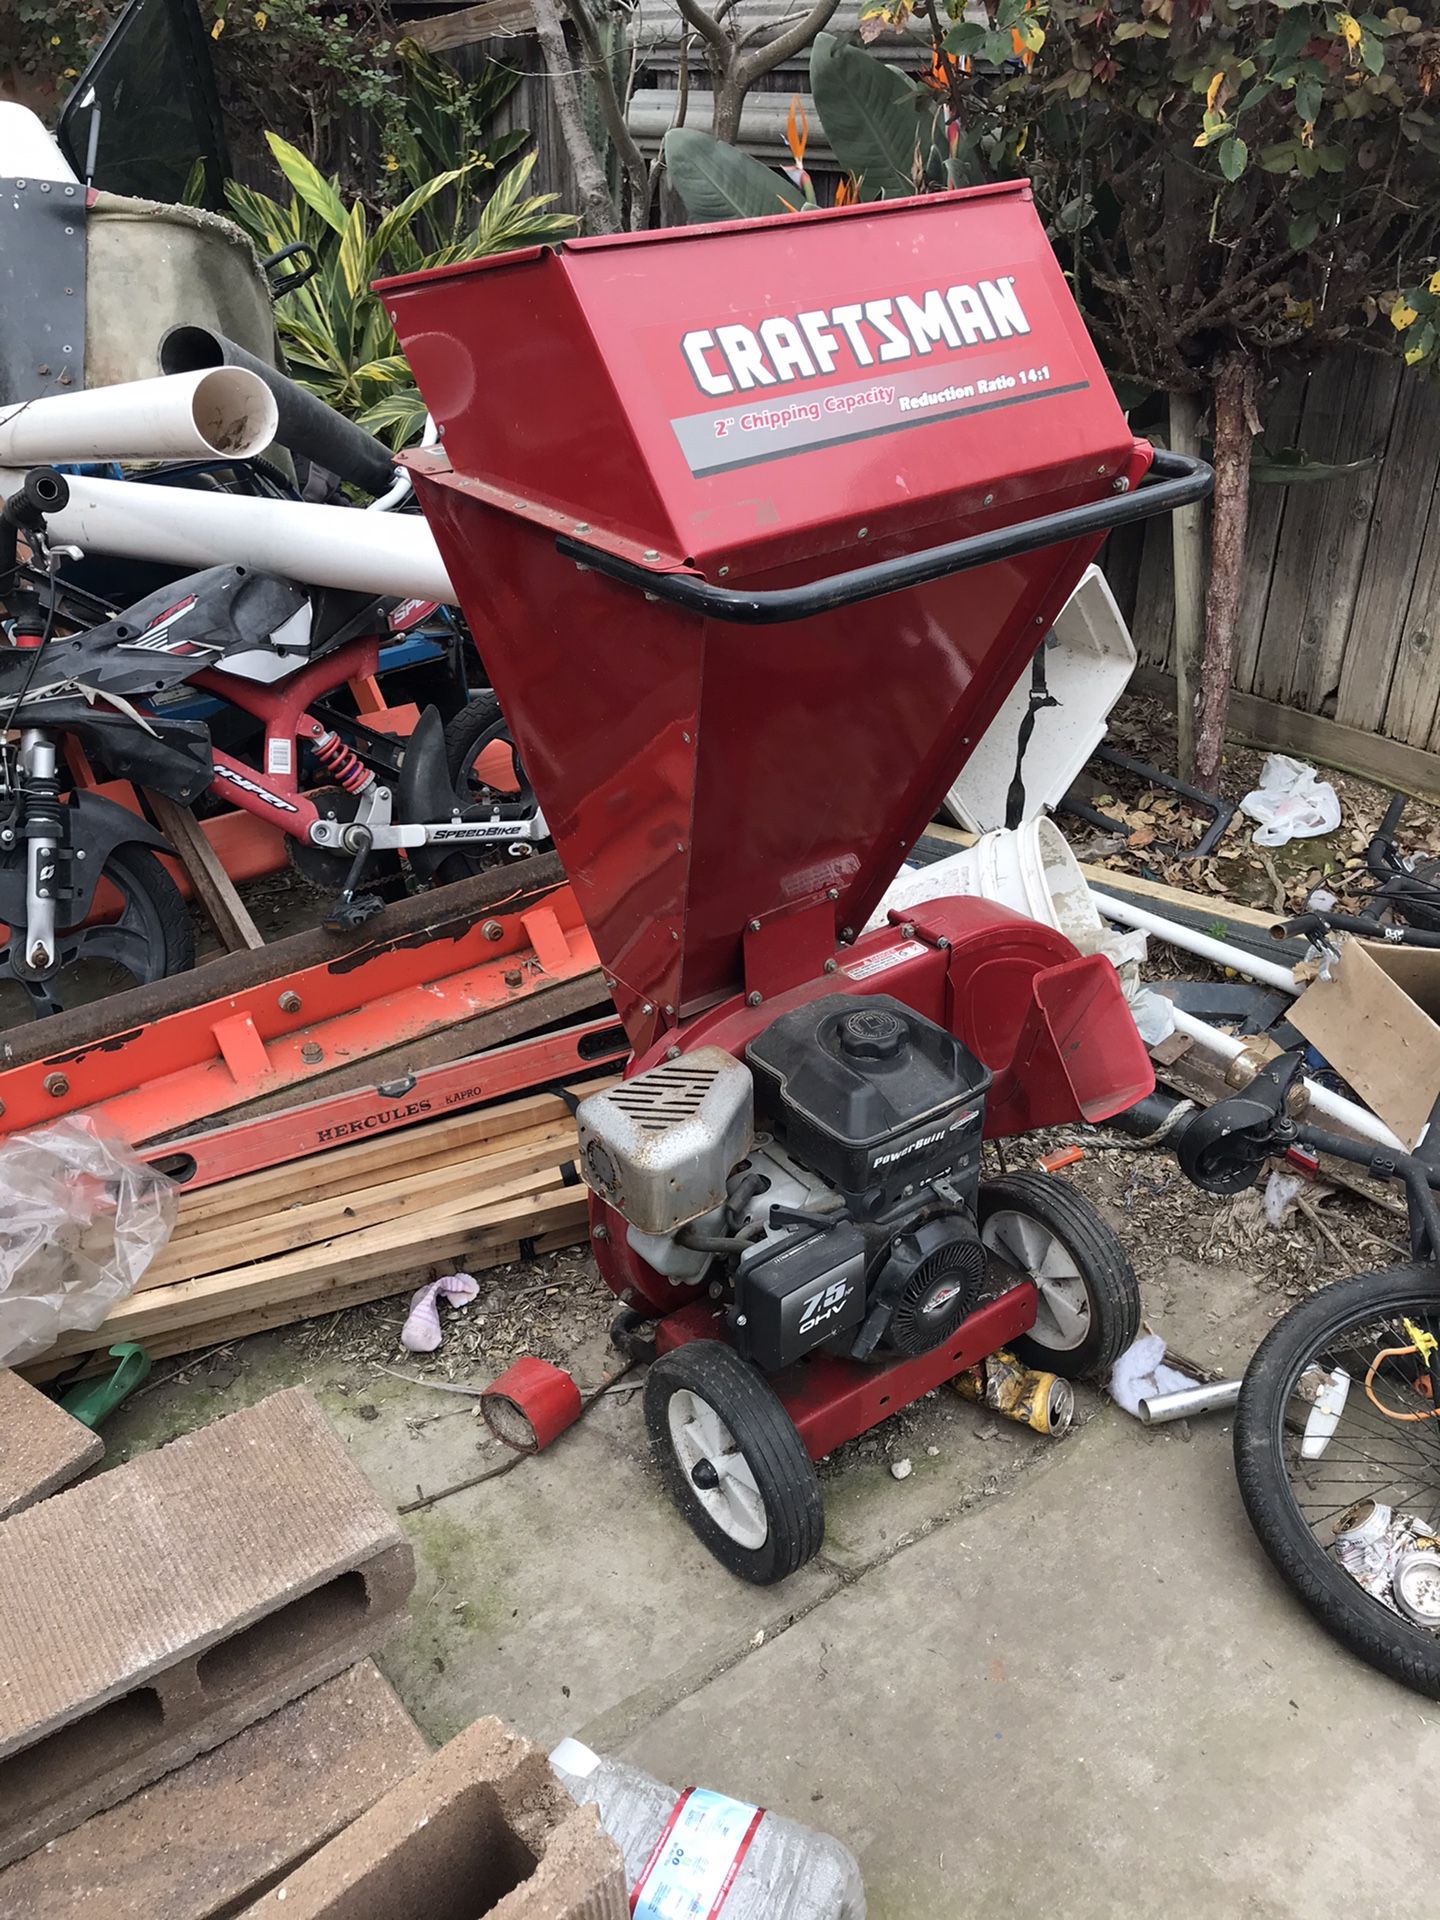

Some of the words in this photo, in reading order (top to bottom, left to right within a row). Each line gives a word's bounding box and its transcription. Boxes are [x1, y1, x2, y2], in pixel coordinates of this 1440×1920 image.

[682, 277, 1030, 396] CRAFTSMAN
[715, 418, 734, 438] 2"
[739, 403, 820, 431] Chipping
[824, 386, 896, 413] Capacity
[898, 386, 975, 412] Reduction
[976, 375, 1016, 394] Ratio
[1018, 365, 1050, 385] 14:1
[317, 1100, 432, 1143] HERCULES
[445, 1087, 482, 1104] KAPRO
[873, 1130, 945, 1168] PowerBuilt
[799, 1299, 847, 1334] OHV
